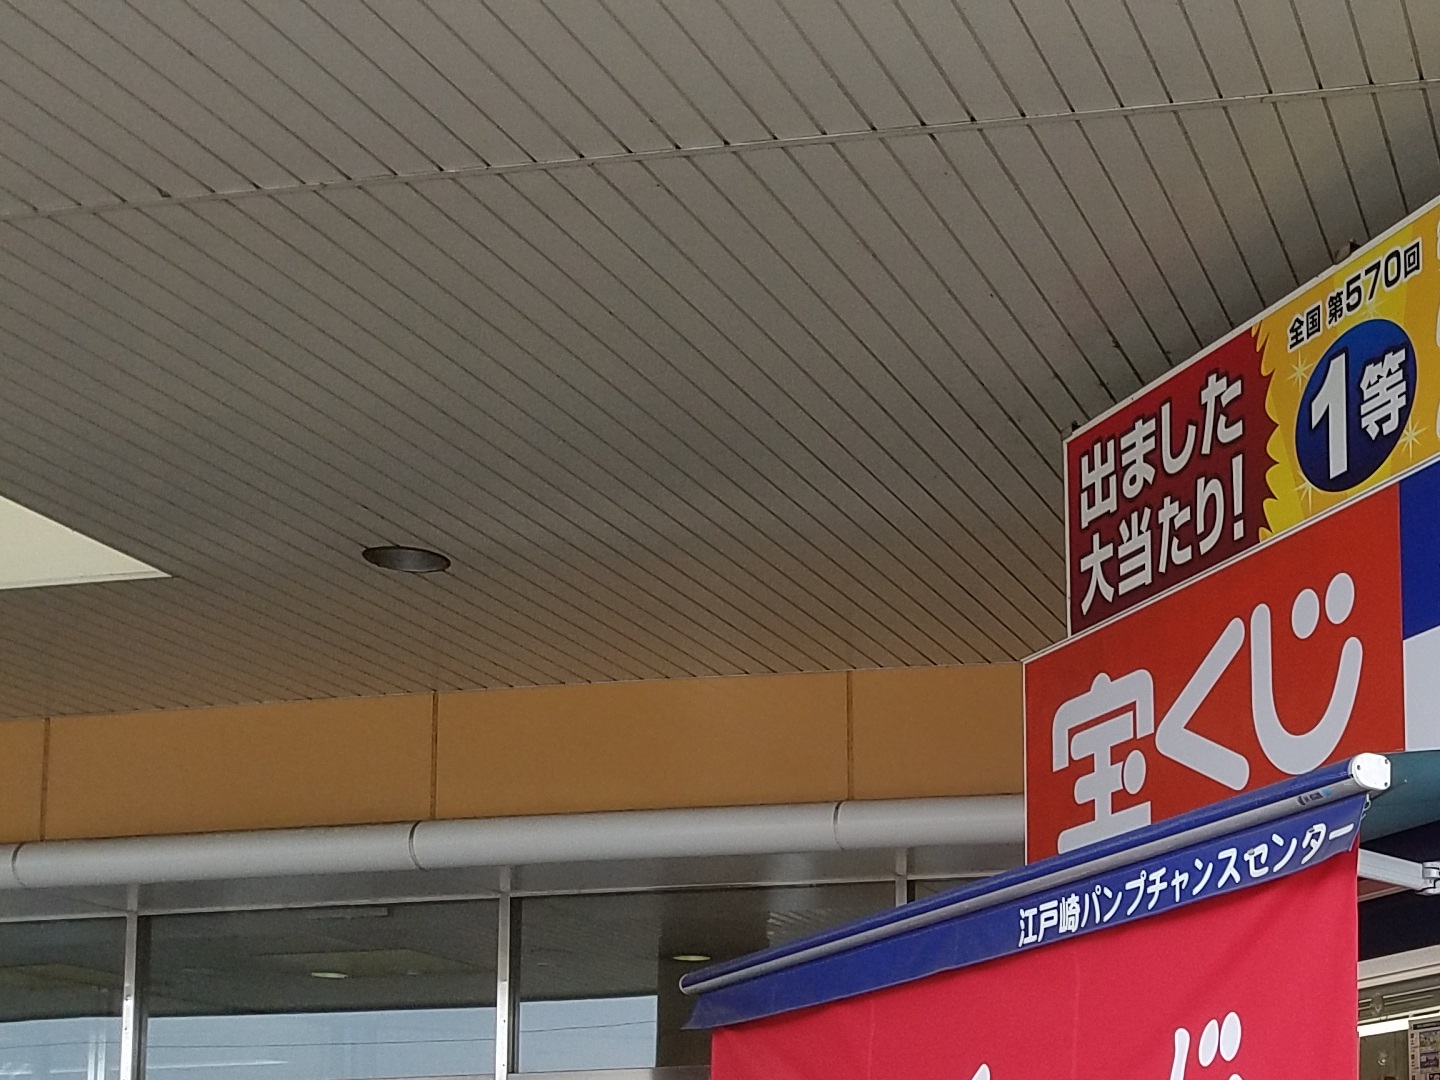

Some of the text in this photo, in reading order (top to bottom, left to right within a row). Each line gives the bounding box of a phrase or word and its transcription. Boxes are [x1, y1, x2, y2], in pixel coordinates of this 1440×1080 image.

[1287, 310, 1322, 349] 全国
[1327, 243, 1422, 328] 第570回
[1080, 371, 1243, 525] 出ました
[1308, 338, 1410, 481] 1等
[1080, 455, 1246, 616] 大当たり!
[1051, 572, 1363, 855] 宝くじ
[1017, 822, 1355, 948] 江戸崎パンプチャンスセンター
